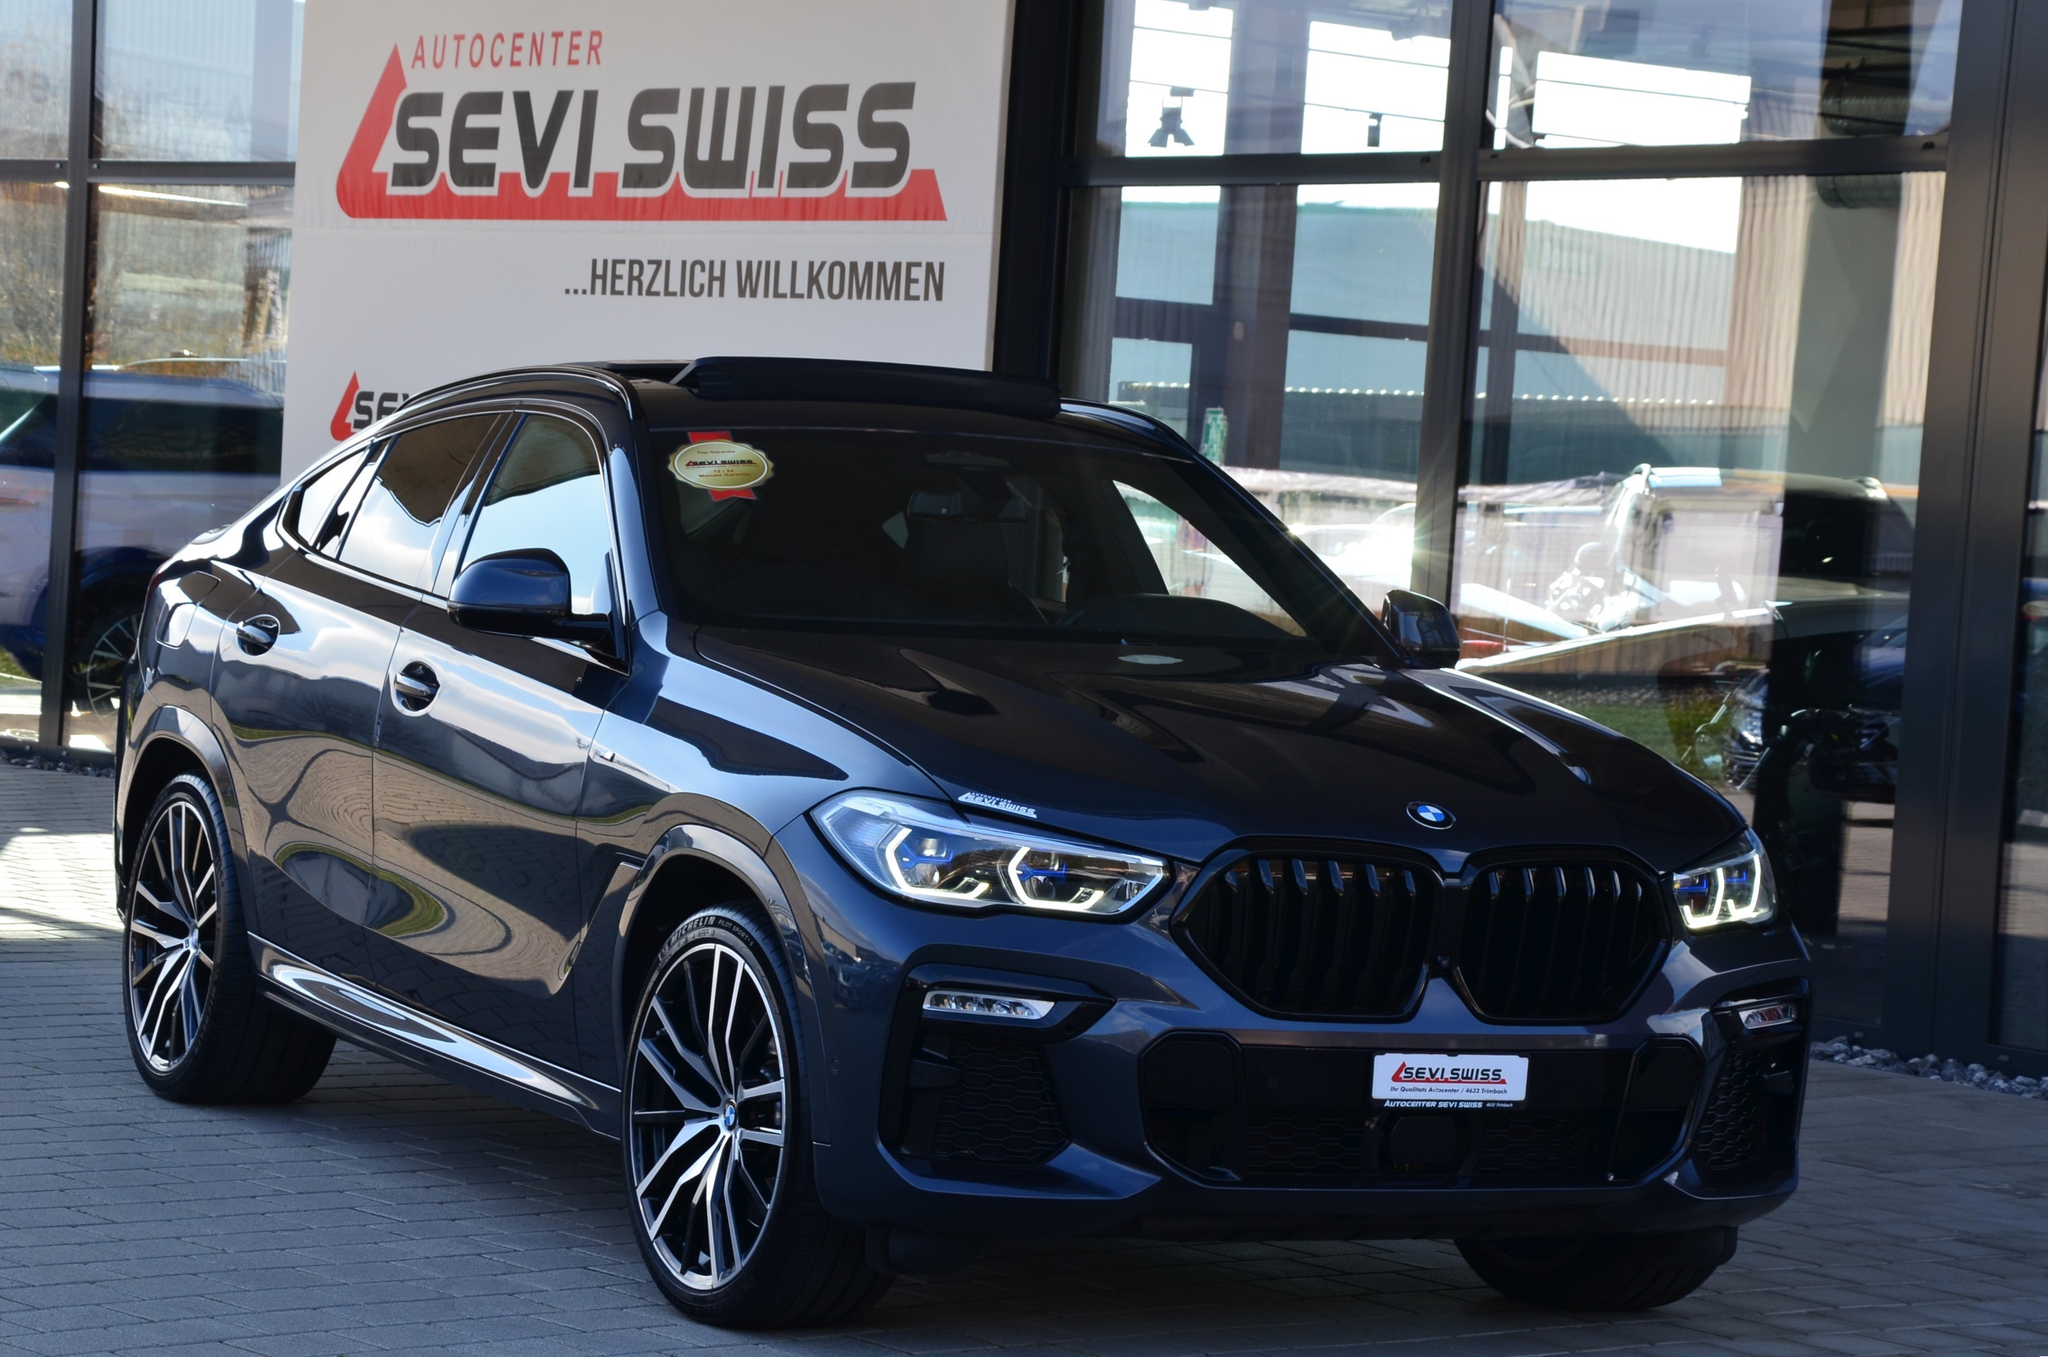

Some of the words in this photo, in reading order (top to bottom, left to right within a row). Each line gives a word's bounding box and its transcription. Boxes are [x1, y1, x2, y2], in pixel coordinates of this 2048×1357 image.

[411, 30, 603, 69] AUTOCENTER
[391, 89, 599, 189] SEVI
[621, 81, 916, 190] SWISS
[564, 258, 726, 298] ...HERZLICH
[735, 260, 945, 302] WILLKOMMEN
[1000, 801, 1036, 815] SWISS
[671, 916, 716, 944] MICHELIN
[717, 919, 733, 930] PILOT
[732, 926, 748, 941] SPORT
[1403, 1067, 1445, 1080] SEVI
[1450, 1068, 1502, 1081] SWISS
